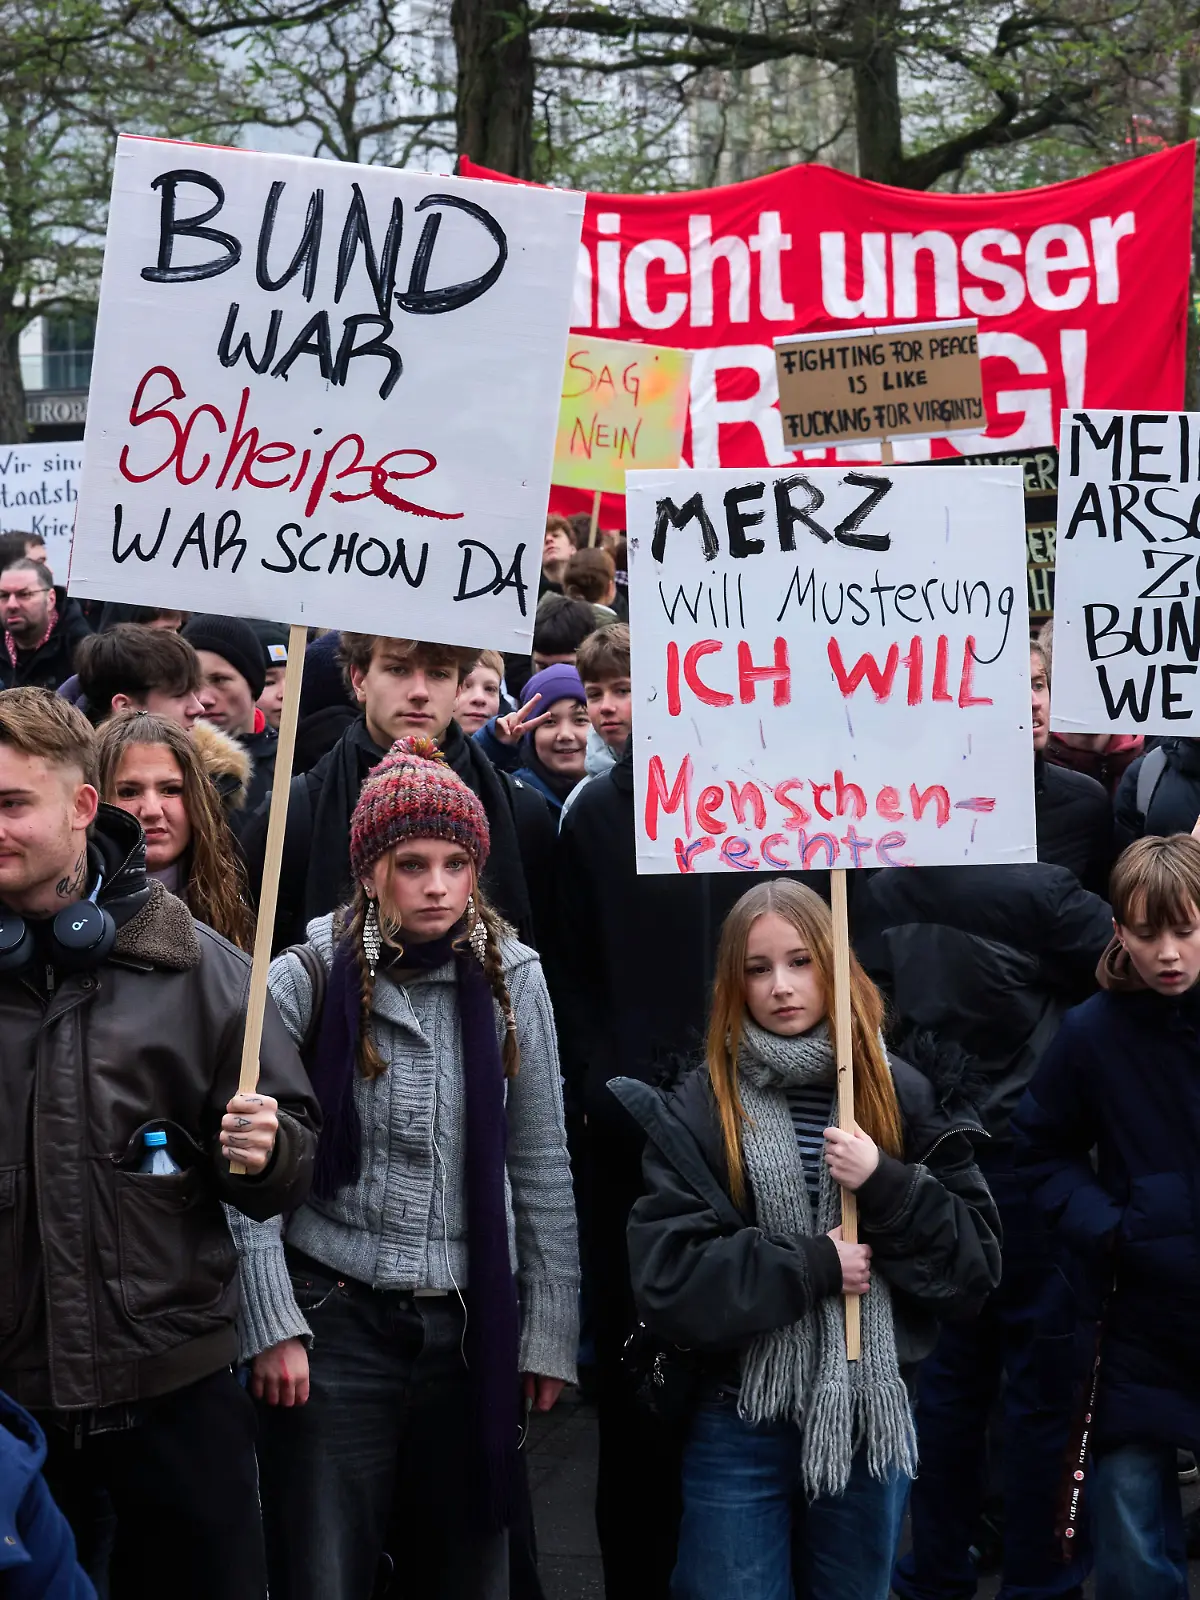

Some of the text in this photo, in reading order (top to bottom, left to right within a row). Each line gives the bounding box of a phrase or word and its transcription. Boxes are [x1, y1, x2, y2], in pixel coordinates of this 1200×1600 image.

[141, 169, 509, 315] BUND
[820, 211, 1136, 320] unser
[217, 302, 404, 401] WAR
[780, 335, 978, 375] FIGHTING FOR PEACE
[848, 370, 928, 394] IS LIKE
[569, 412, 643, 460] NEIN
[785, 408, 871, 438] FUCKING
[873, 402, 911, 429] FOR
[1070, 413, 1200, 483] MEI
[43, 453, 83, 473] sin
[650, 472, 893, 562] MERZ
[1065, 482, 1200, 543] ARS
[113, 504, 528, 616] WAR SCHON DA
[1138, 549, 1200, 598] Z
[776, 565, 1014, 664] Musterung
[666, 634, 993, 717] ICH WILL
[1096, 663, 1198, 722] WE
[644, 753, 997, 841] Menschen-
[674, 824, 915, 874] rechte
